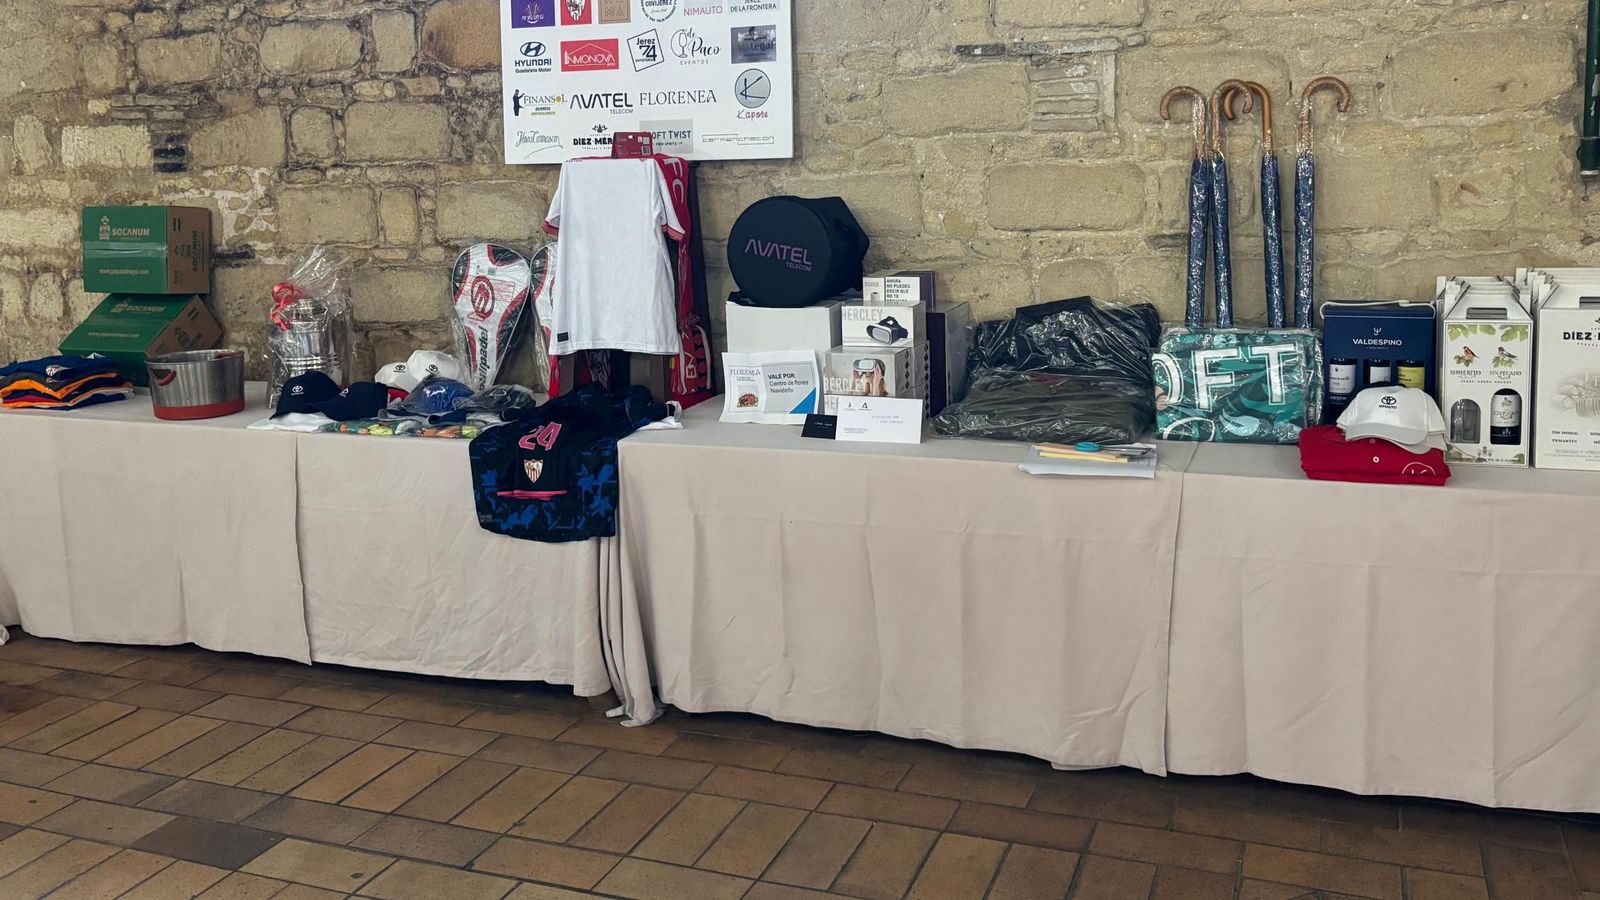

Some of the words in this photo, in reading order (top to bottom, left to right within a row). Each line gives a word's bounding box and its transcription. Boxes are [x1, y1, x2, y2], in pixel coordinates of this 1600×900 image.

[683, 6, 723, 16] NIMAUTO
[636, 38, 656, 46] Jerez
[688, 37, 721, 57] Paco
[639, 45, 657, 61] 74
[514, 59, 552, 67] HYUNDAI
[569, 93, 633, 109] AVATEL
[639, 90, 717, 105] FLORENEA
[669, 131, 692, 139] TWIST
[744, 239, 812, 265] AVATEL
[785, 262, 811, 271] TELECOM
[1352, 338, 1402, 346] VALDESPINO
[518, 421, 562, 451] 24
